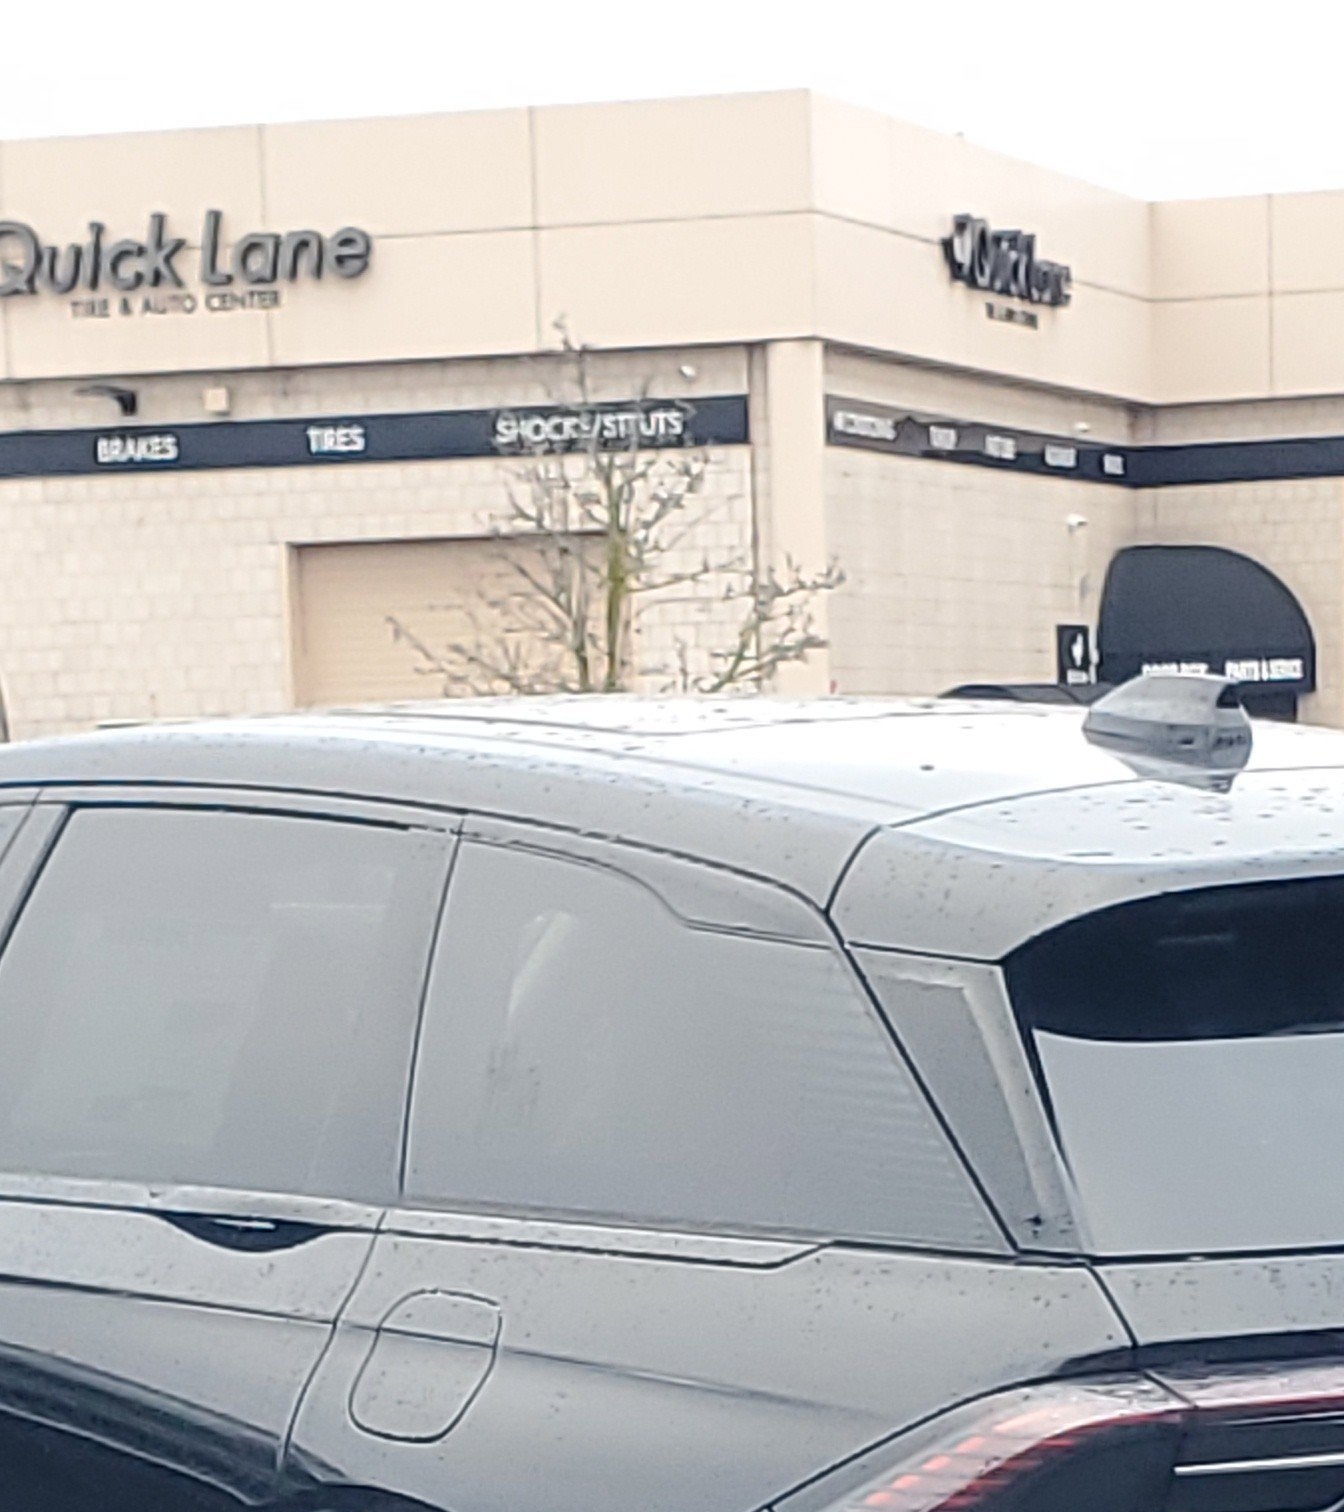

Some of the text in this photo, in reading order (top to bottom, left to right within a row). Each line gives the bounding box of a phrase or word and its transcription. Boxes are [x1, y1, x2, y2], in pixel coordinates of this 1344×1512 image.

[204, 210, 372, 286] Lane
[96, 433, 179, 463] BRAKES
[307, 425, 366, 454] TIRES
